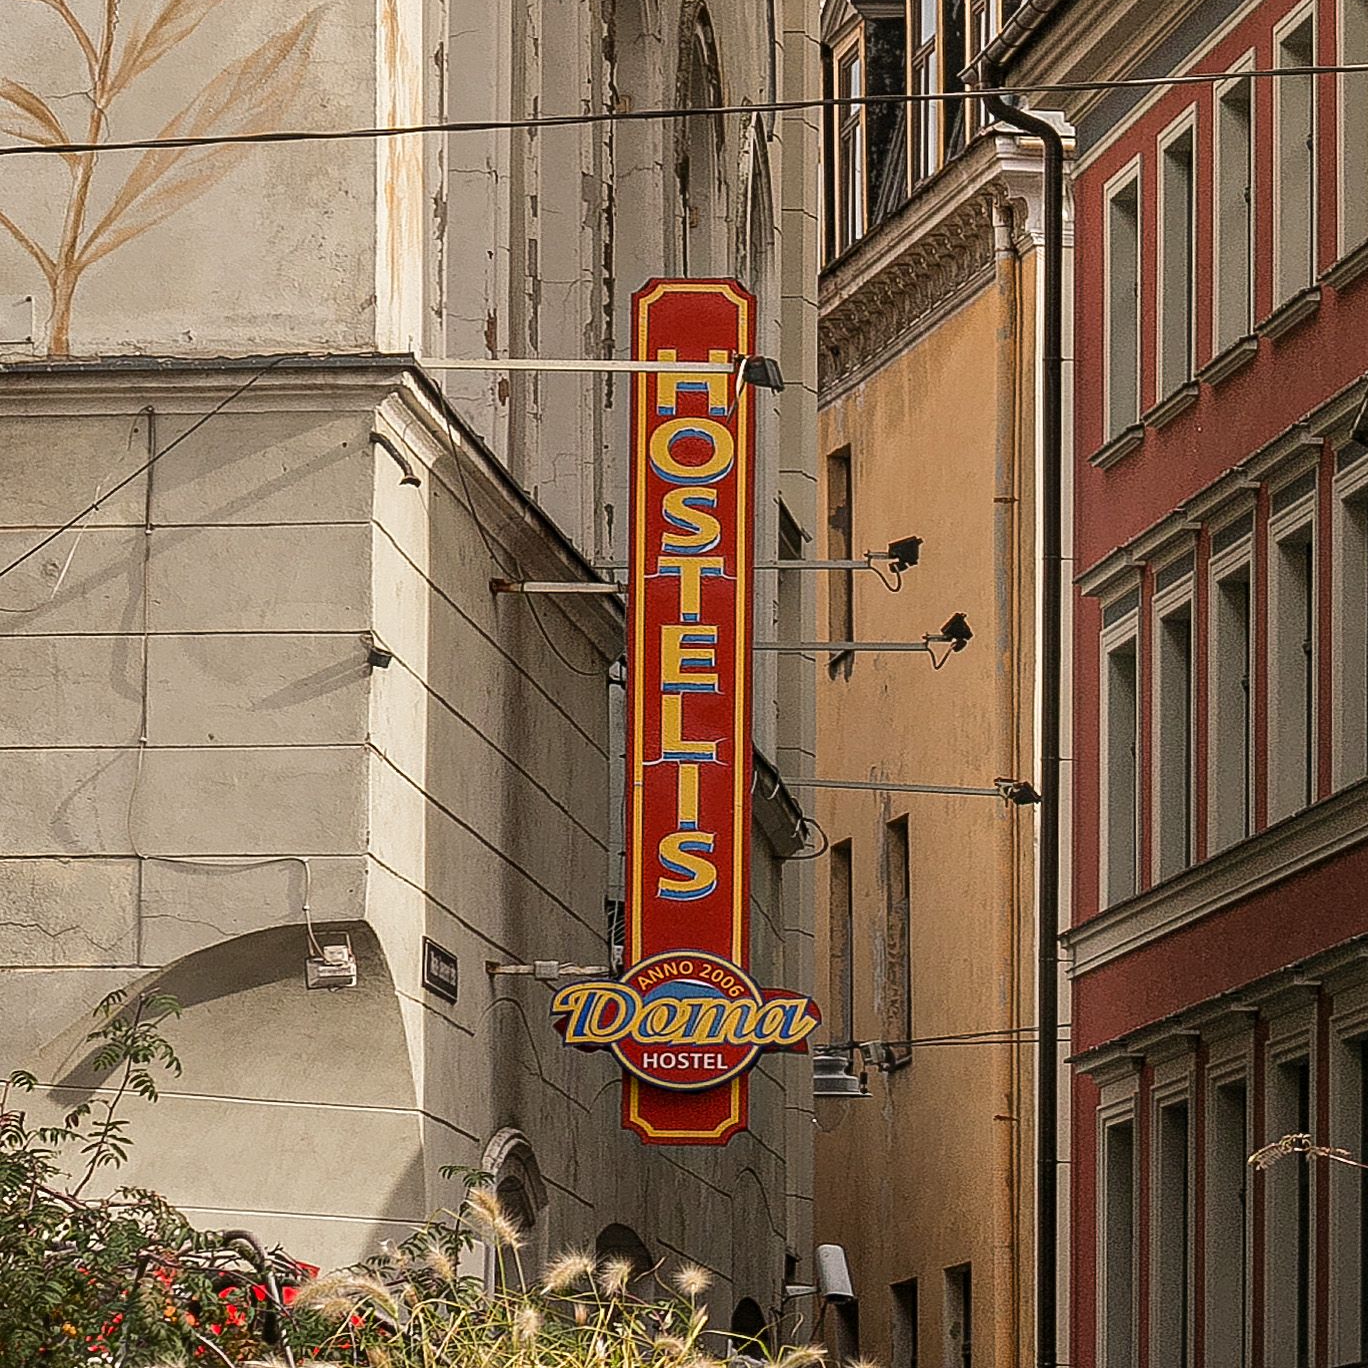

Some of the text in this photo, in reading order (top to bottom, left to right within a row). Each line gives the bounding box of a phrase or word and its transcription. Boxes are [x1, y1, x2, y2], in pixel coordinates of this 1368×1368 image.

[648, 348, 735, 903] HOSTELIS
[637, 960, 745, 998] ANNO 2006
[552, 981, 818, 1045] Doma
[642, 1052, 729, 1070] HOSTEL
